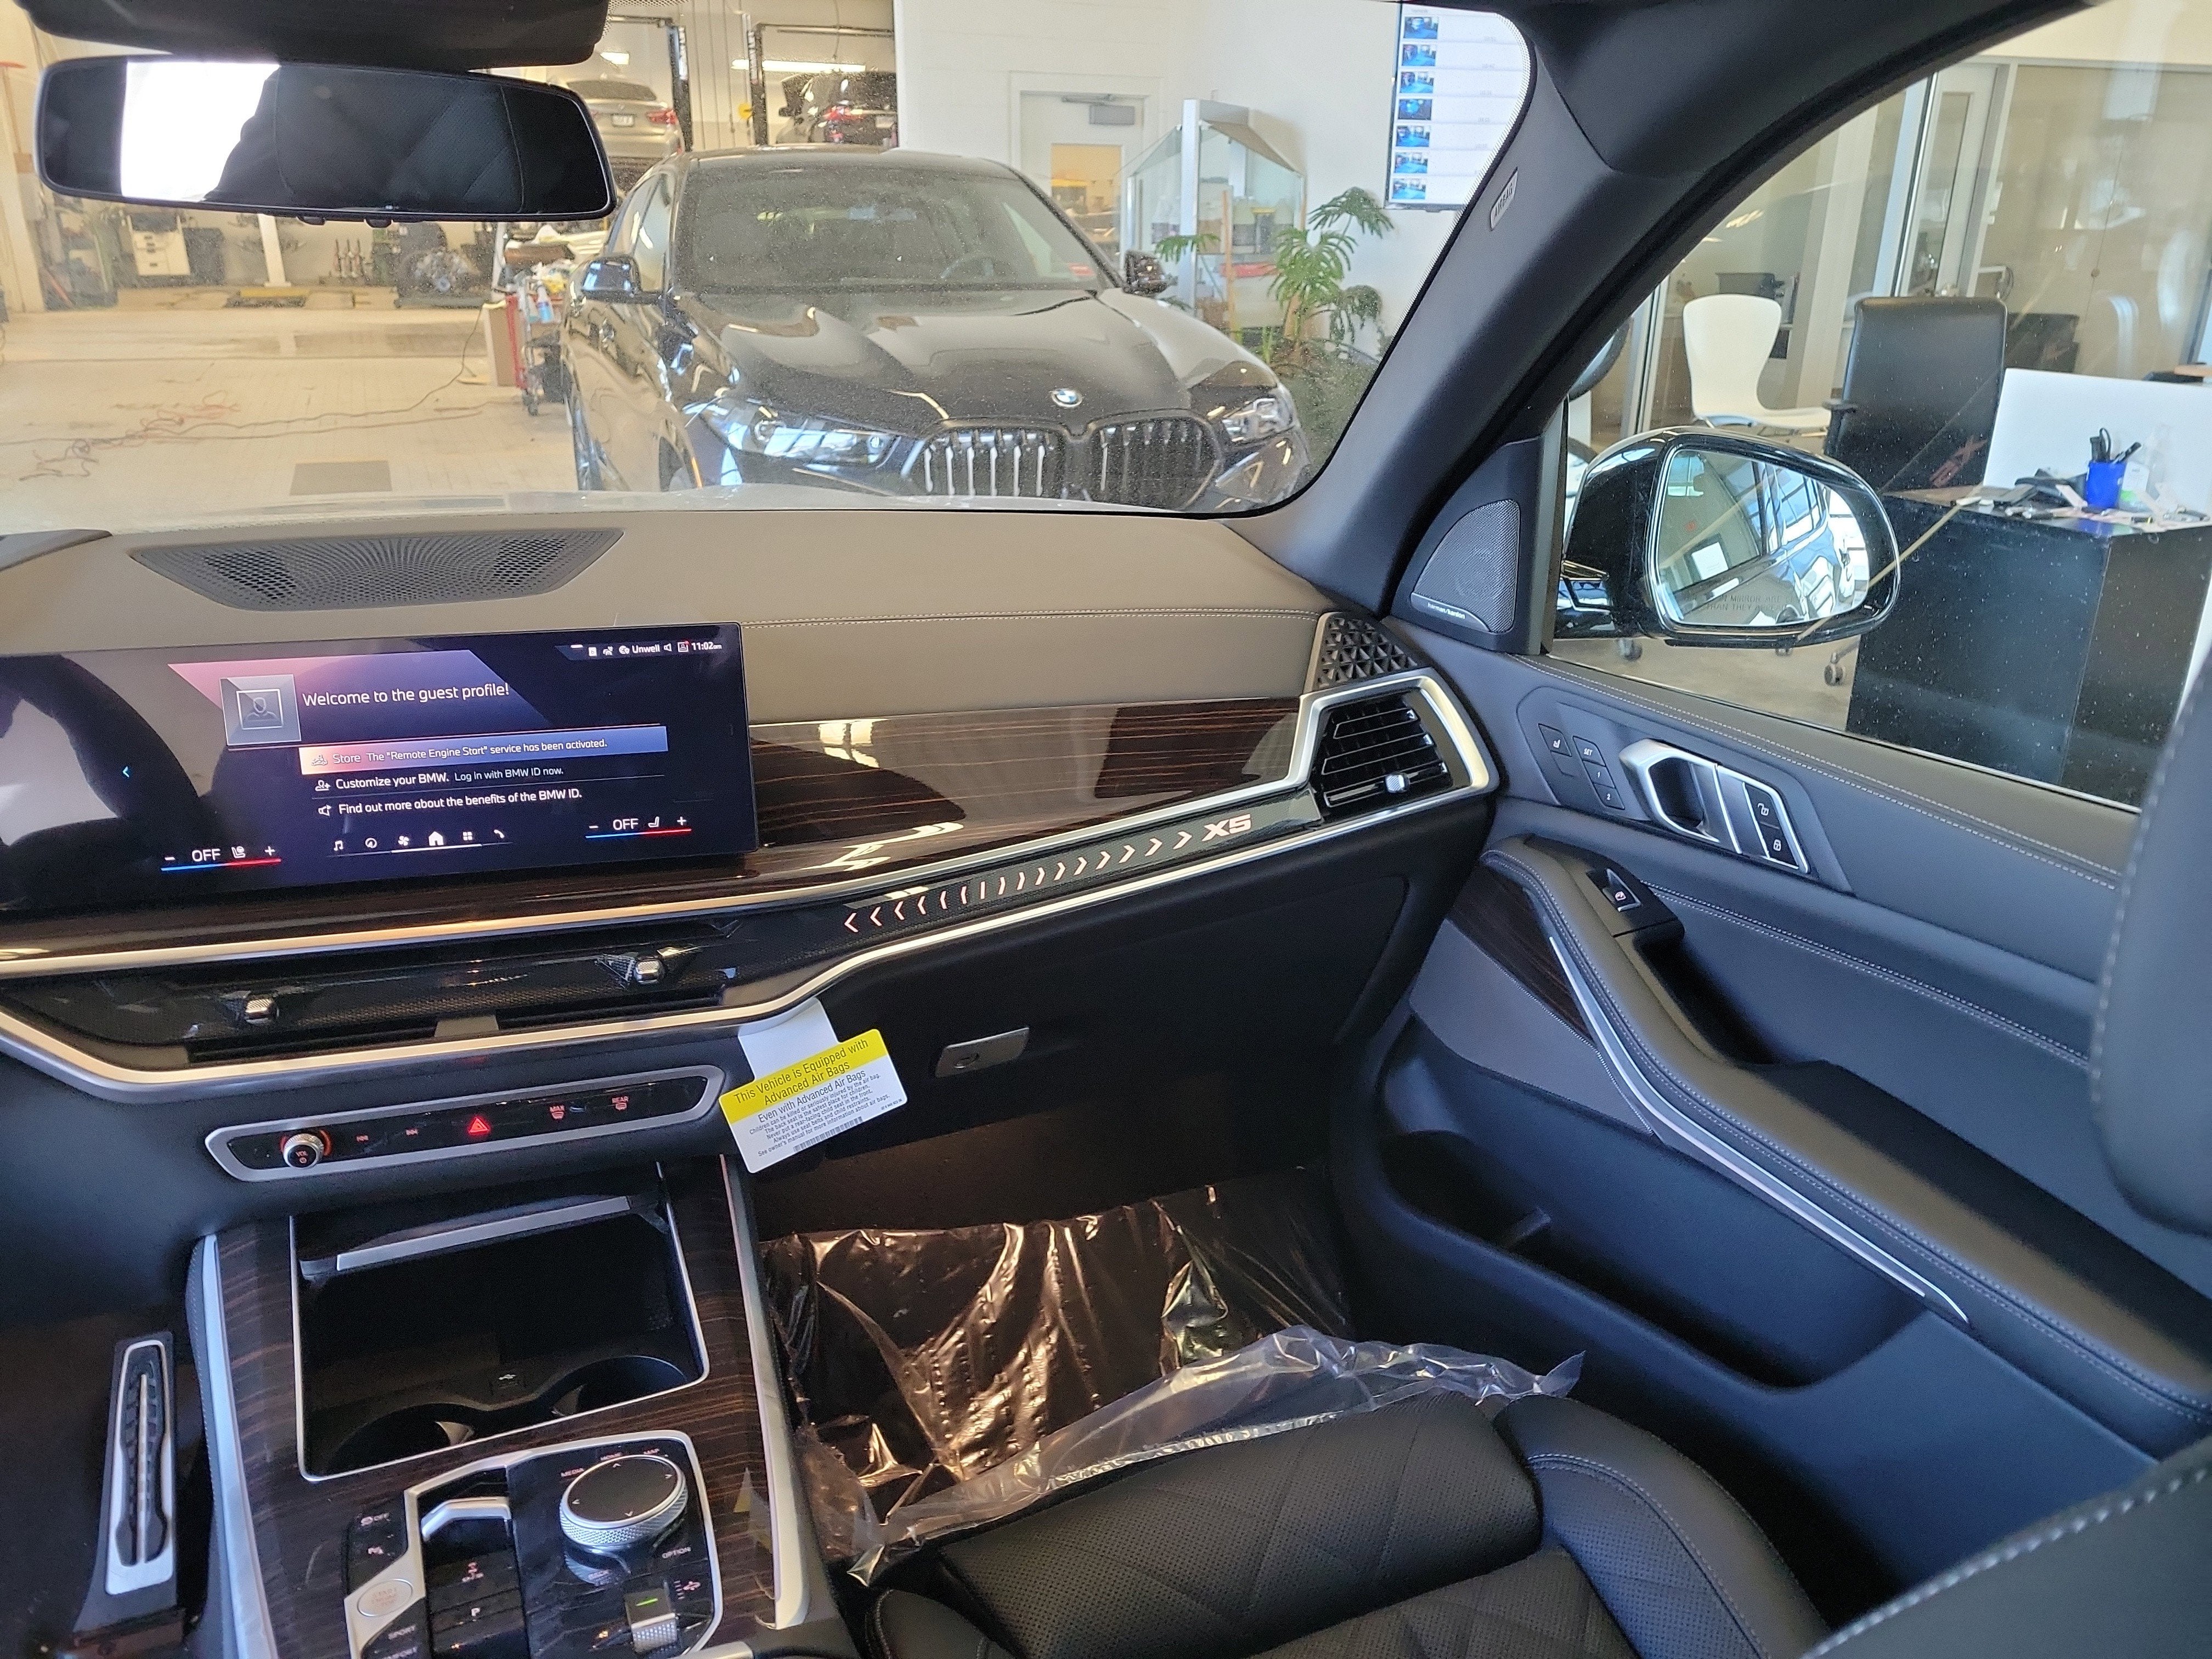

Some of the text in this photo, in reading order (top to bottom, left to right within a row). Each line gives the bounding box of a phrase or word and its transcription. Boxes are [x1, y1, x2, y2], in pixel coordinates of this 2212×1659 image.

[632, 644, 661, 653] Unwell
[302, 682, 510, 707] Welcome to the guest profile!
[332, 738, 608, 764] Store The "Remote Engine Start" service has been activated.
[1584, 748, 1593, 756] SET
[335, 776, 392, 790] Customize
[390, 776, 417, 788] your
[417, 771, 450, 784] BMW.
[454, 772, 472, 782] Log
[483, 769, 504, 780] with
[505, 768, 529, 778] BMW
[531, 767, 541, 776] ID
[543, 768, 565, 776] now.
[338, 788, 583, 815] Find out more about the benefits of the BMW ID.
[613, 817, 639, 831] OFF
[1201, 814, 1251, 842] X5
[191, 848, 221, 862] OFF
[734, 1040, 868, 1103] This Vehicle is Equipped with
[765, 1062, 849, 1105] Advanced Air Bags
[758, 1071, 865, 1122] Even with Advanced Air Bags
[812, 1103, 827, 1111] safest
[828, 1097, 840, 1105] place
[849, 1085, 870, 1095] children.
[749, 1123, 770, 1134] Children
[787, 1108, 800, 1117] killed
[808, 1096, 828, 1108] seriously
[830, 1087, 846, 1098] injured
[766, 1131, 780, 1139] Never
[795, 1113, 820, 1126] rear-facing
[821, 1106, 833, 1114] child
[859, 1089, 872, 1097] front.
[774, 1133, 789, 1143] Always
[847, 1097, 870, 1109] restraints.
[768, 1141, 786, 1152] owner's
[787, 1132, 805, 1142] manual
[827, 1110, 854, 1124] information
[855, 1103, 868, 1111] about
[662, 1547, 691, 1559] OPTION
[471, 1607, 481, 1616] P
